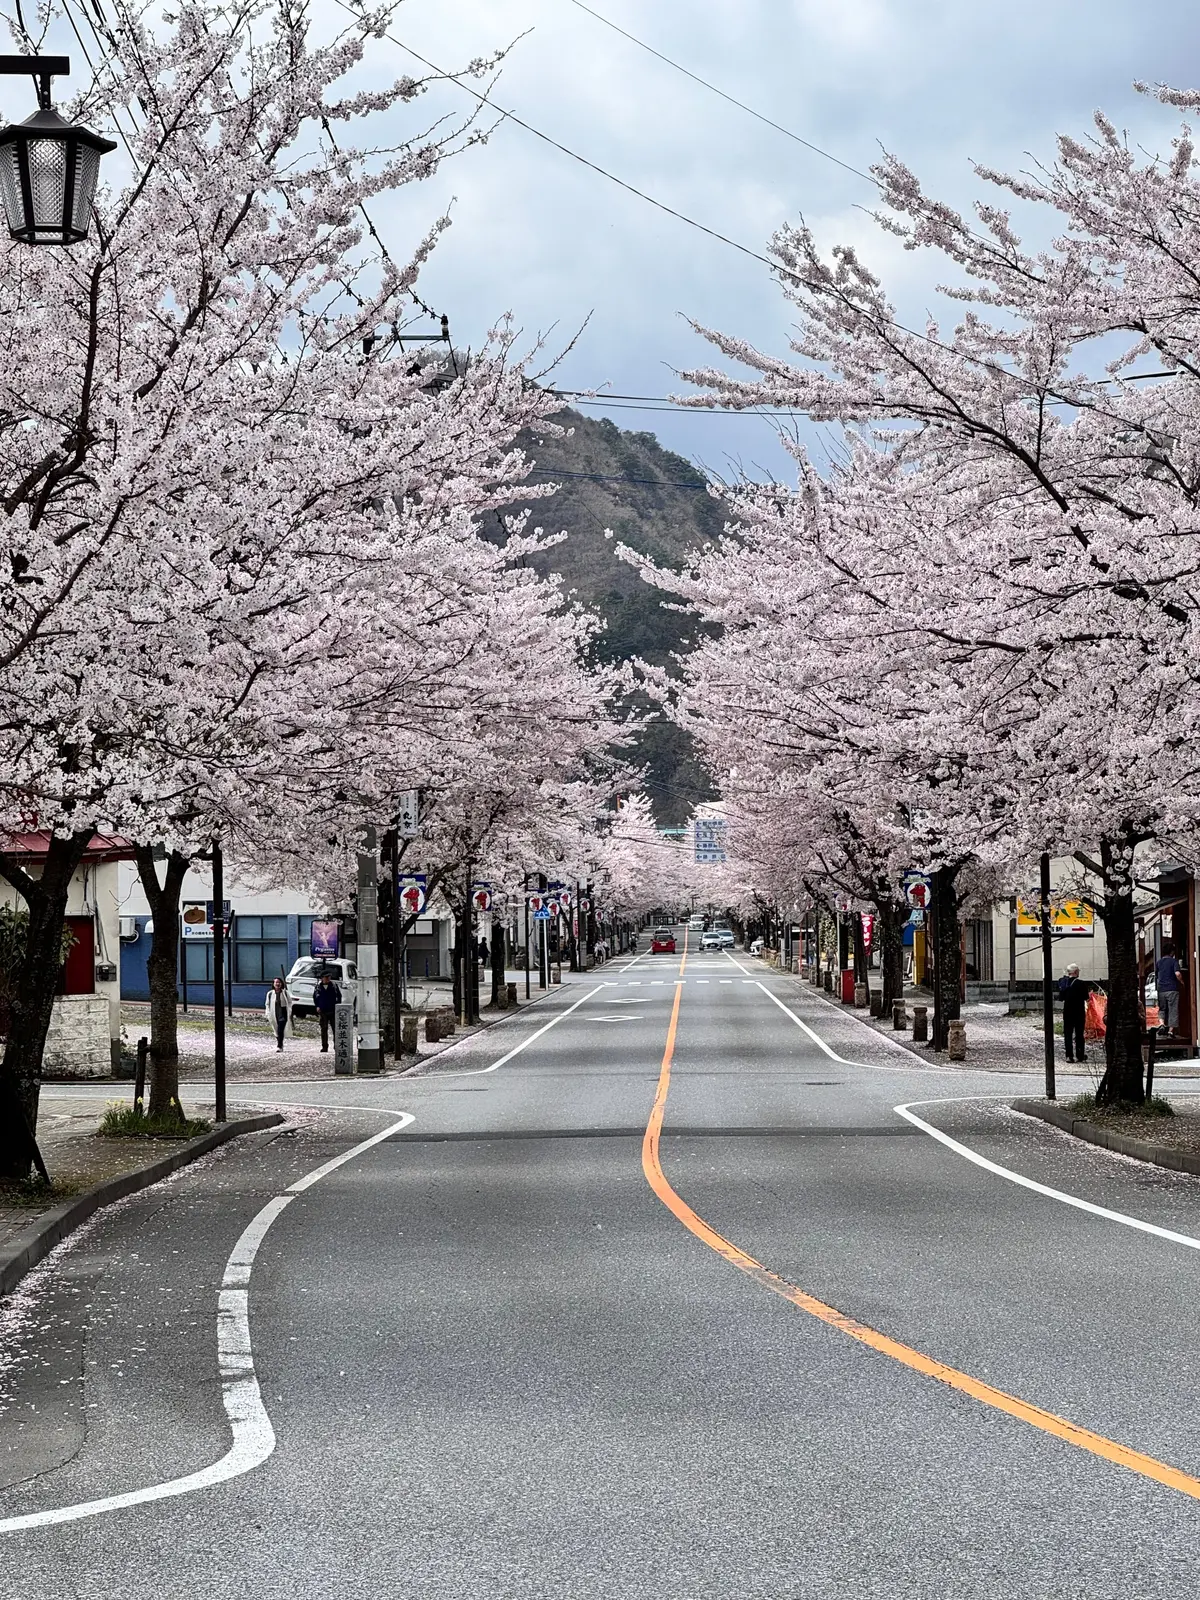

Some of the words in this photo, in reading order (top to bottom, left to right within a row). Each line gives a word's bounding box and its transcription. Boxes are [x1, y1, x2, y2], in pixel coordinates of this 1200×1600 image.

[185, 927, 192, 936] P
[338, 1021, 348, 1067] 桜並木通り
